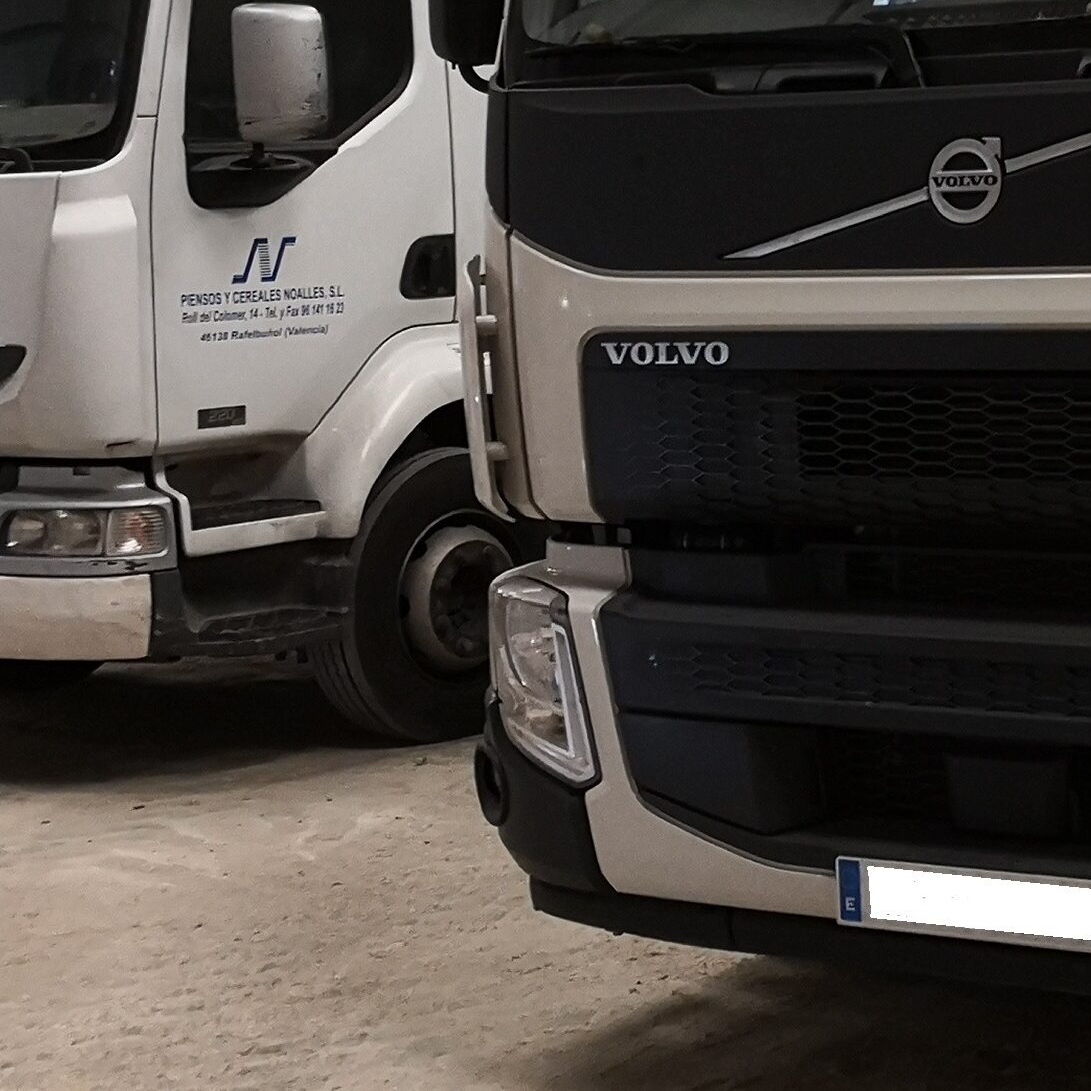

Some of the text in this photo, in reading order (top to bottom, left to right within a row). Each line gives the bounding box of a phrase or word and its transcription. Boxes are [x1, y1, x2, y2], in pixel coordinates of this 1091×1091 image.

[932, 175, 998, 187] VOLVO
[181, 286, 345, 307] PIENSOS Y CEREALES NOALLES, S.L.
[200, 311, 212, 322] del
[250, 308, 258, 319] 14
[265, 306, 277, 318] Tel.
[279, 308, 285, 321] y
[286, 306, 299, 317] Fax
[313, 304, 324, 315] 141
[336, 302, 344, 314] 23
[284, 324, 328, 338] (Valencia)
[600, 341, 730, 366] VOLVO
[846, 896, 856, 911] E
